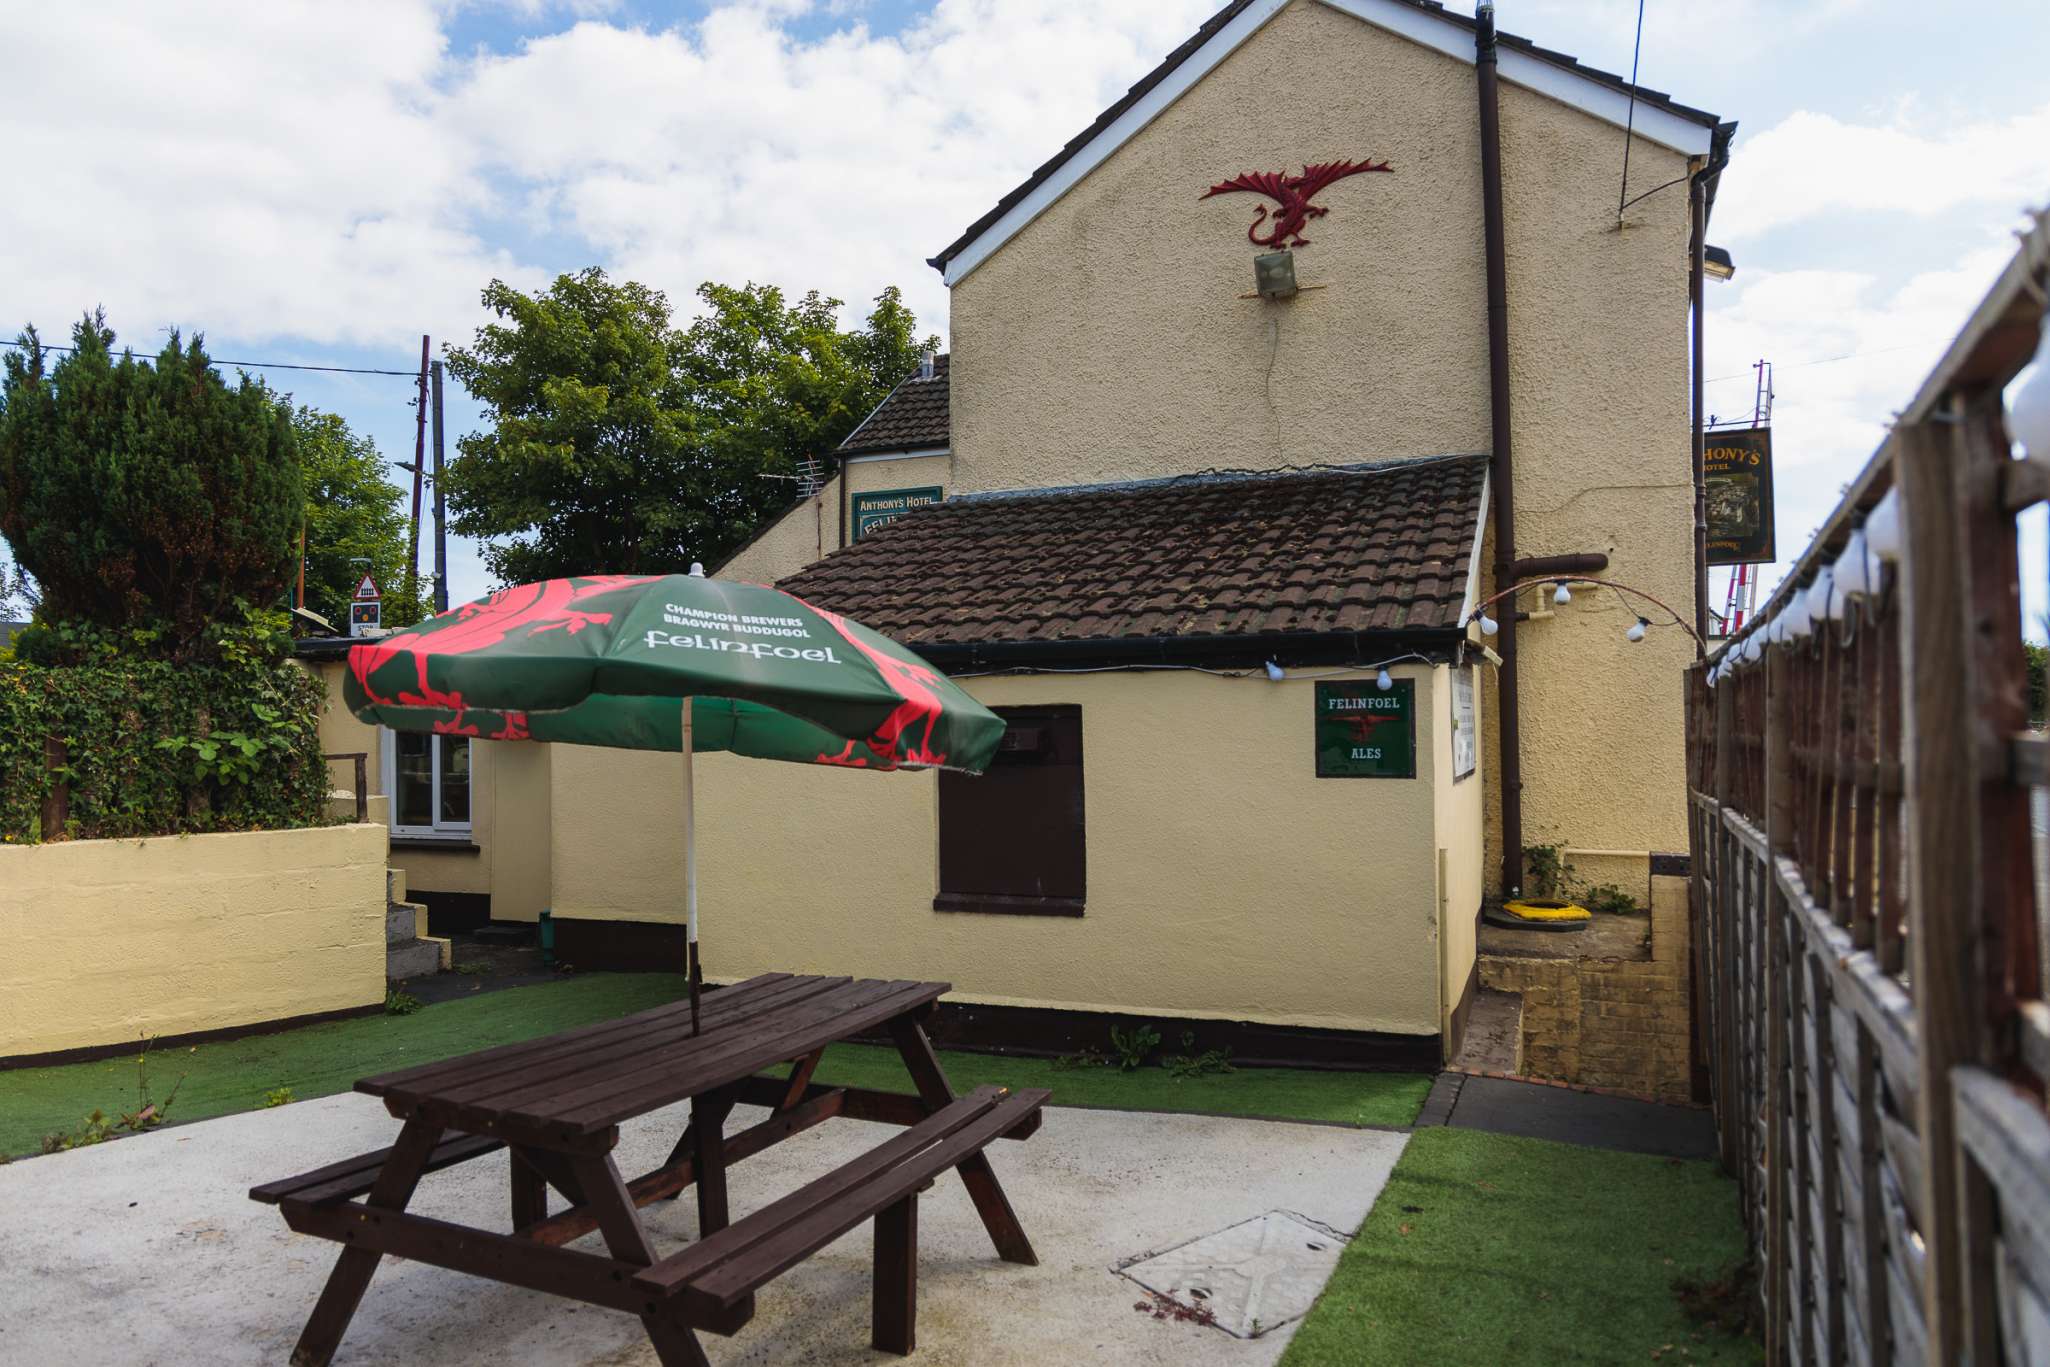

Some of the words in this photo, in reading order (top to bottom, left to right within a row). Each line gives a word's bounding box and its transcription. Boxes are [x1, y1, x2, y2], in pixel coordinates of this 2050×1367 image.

[1703, 447, 1761, 465] HONY'S
[1703, 463, 1730, 472] OTEL
[906, 496, 934, 508] HOTEL
[665, 603, 738, 622] CHAMPION
[741, 614, 804, 627] BREWERS
[663, 613, 730, 631] BRAGWYR
[732, 623, 811, 638] BUDDUGOL
[1328, 697, 1401, 710] FELINFOEL
[1351, 747, 1382, 759] ALES
